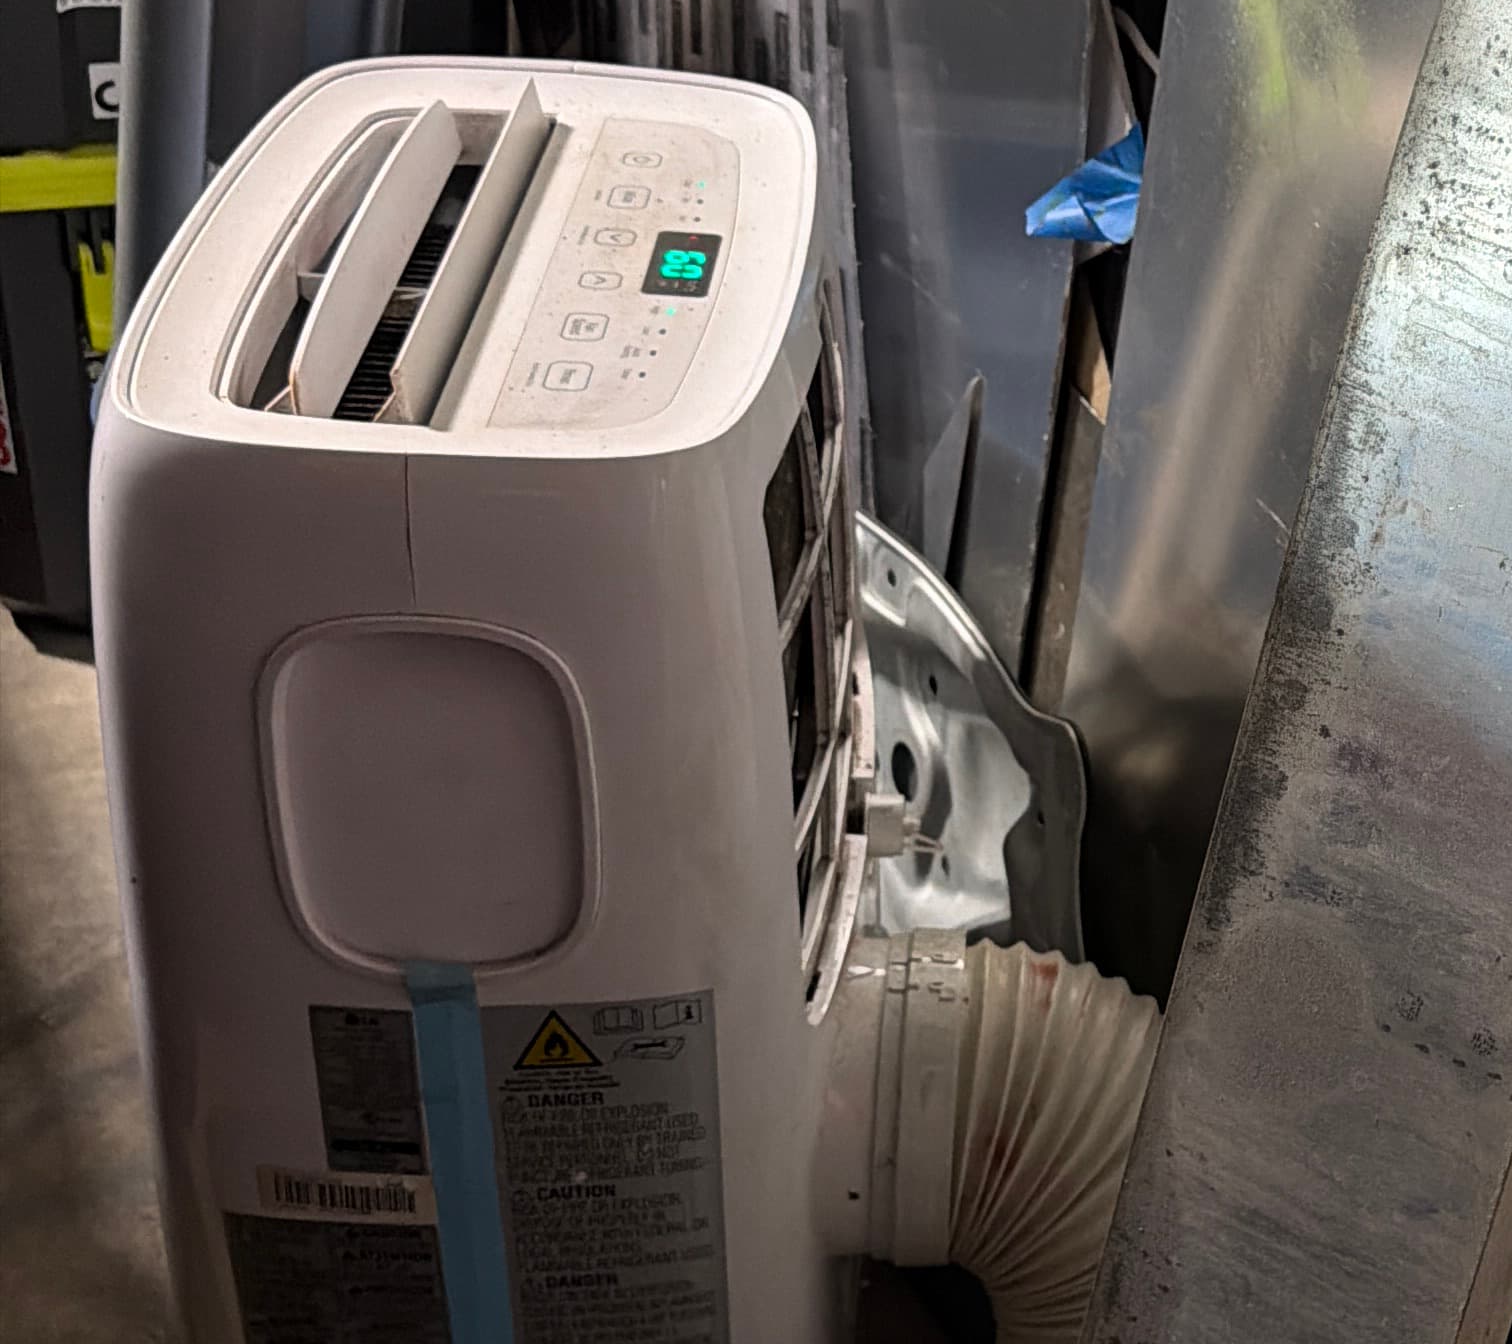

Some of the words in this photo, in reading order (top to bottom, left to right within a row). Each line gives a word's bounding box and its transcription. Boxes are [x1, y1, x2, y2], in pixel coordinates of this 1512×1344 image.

[528, 1092, 604, 1107] DANGER
[537, 1185, 617, 1201] CAUTION
[545, 1273, 619, 1289] DANGER
